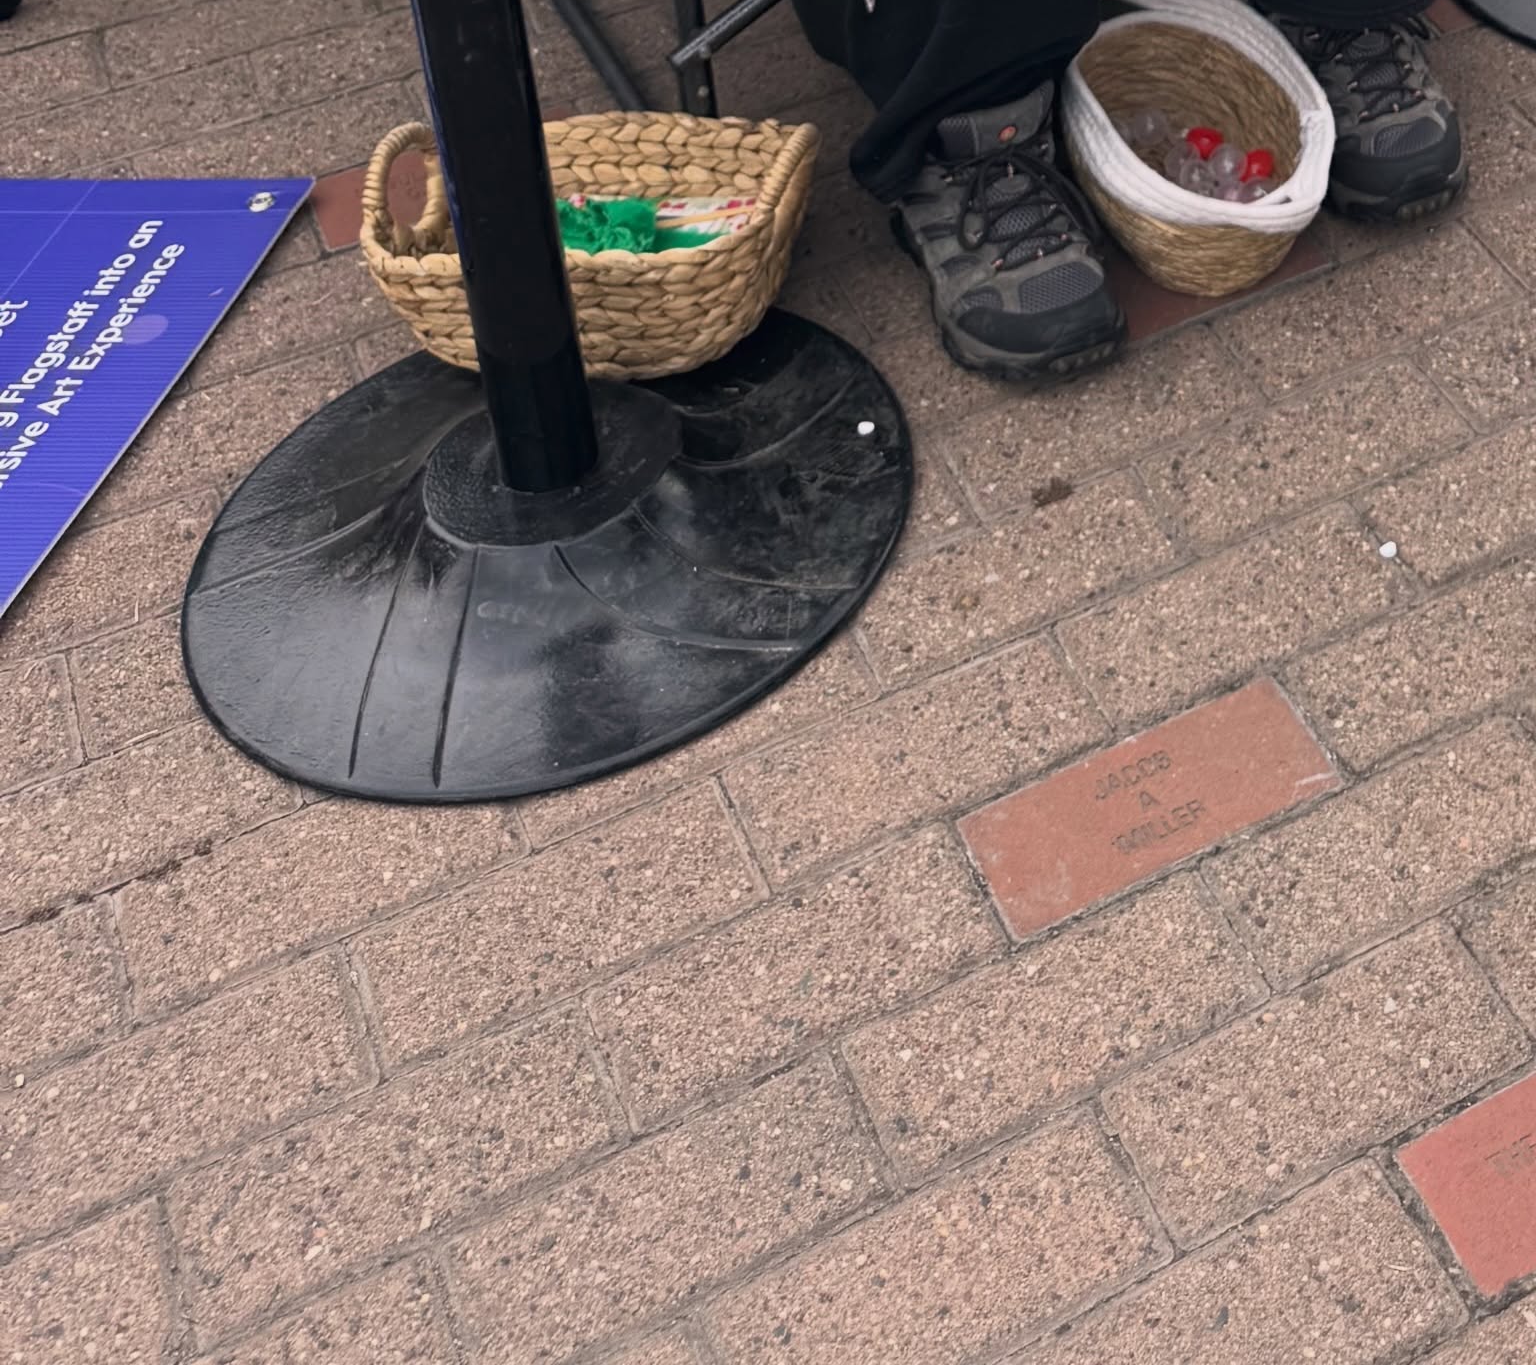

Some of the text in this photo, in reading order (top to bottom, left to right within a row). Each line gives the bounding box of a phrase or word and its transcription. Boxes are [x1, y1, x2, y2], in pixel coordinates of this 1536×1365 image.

[0, 219, 164, 403] Flagstaff into an
[36, 376, 84, 418] Art
[68, 242, 186, 372] Experience
[1094, 750, 1173, 802] JACOB
[1138, 790, 1161, 814] A
[1112, 798, 1207, 857] MILLER
